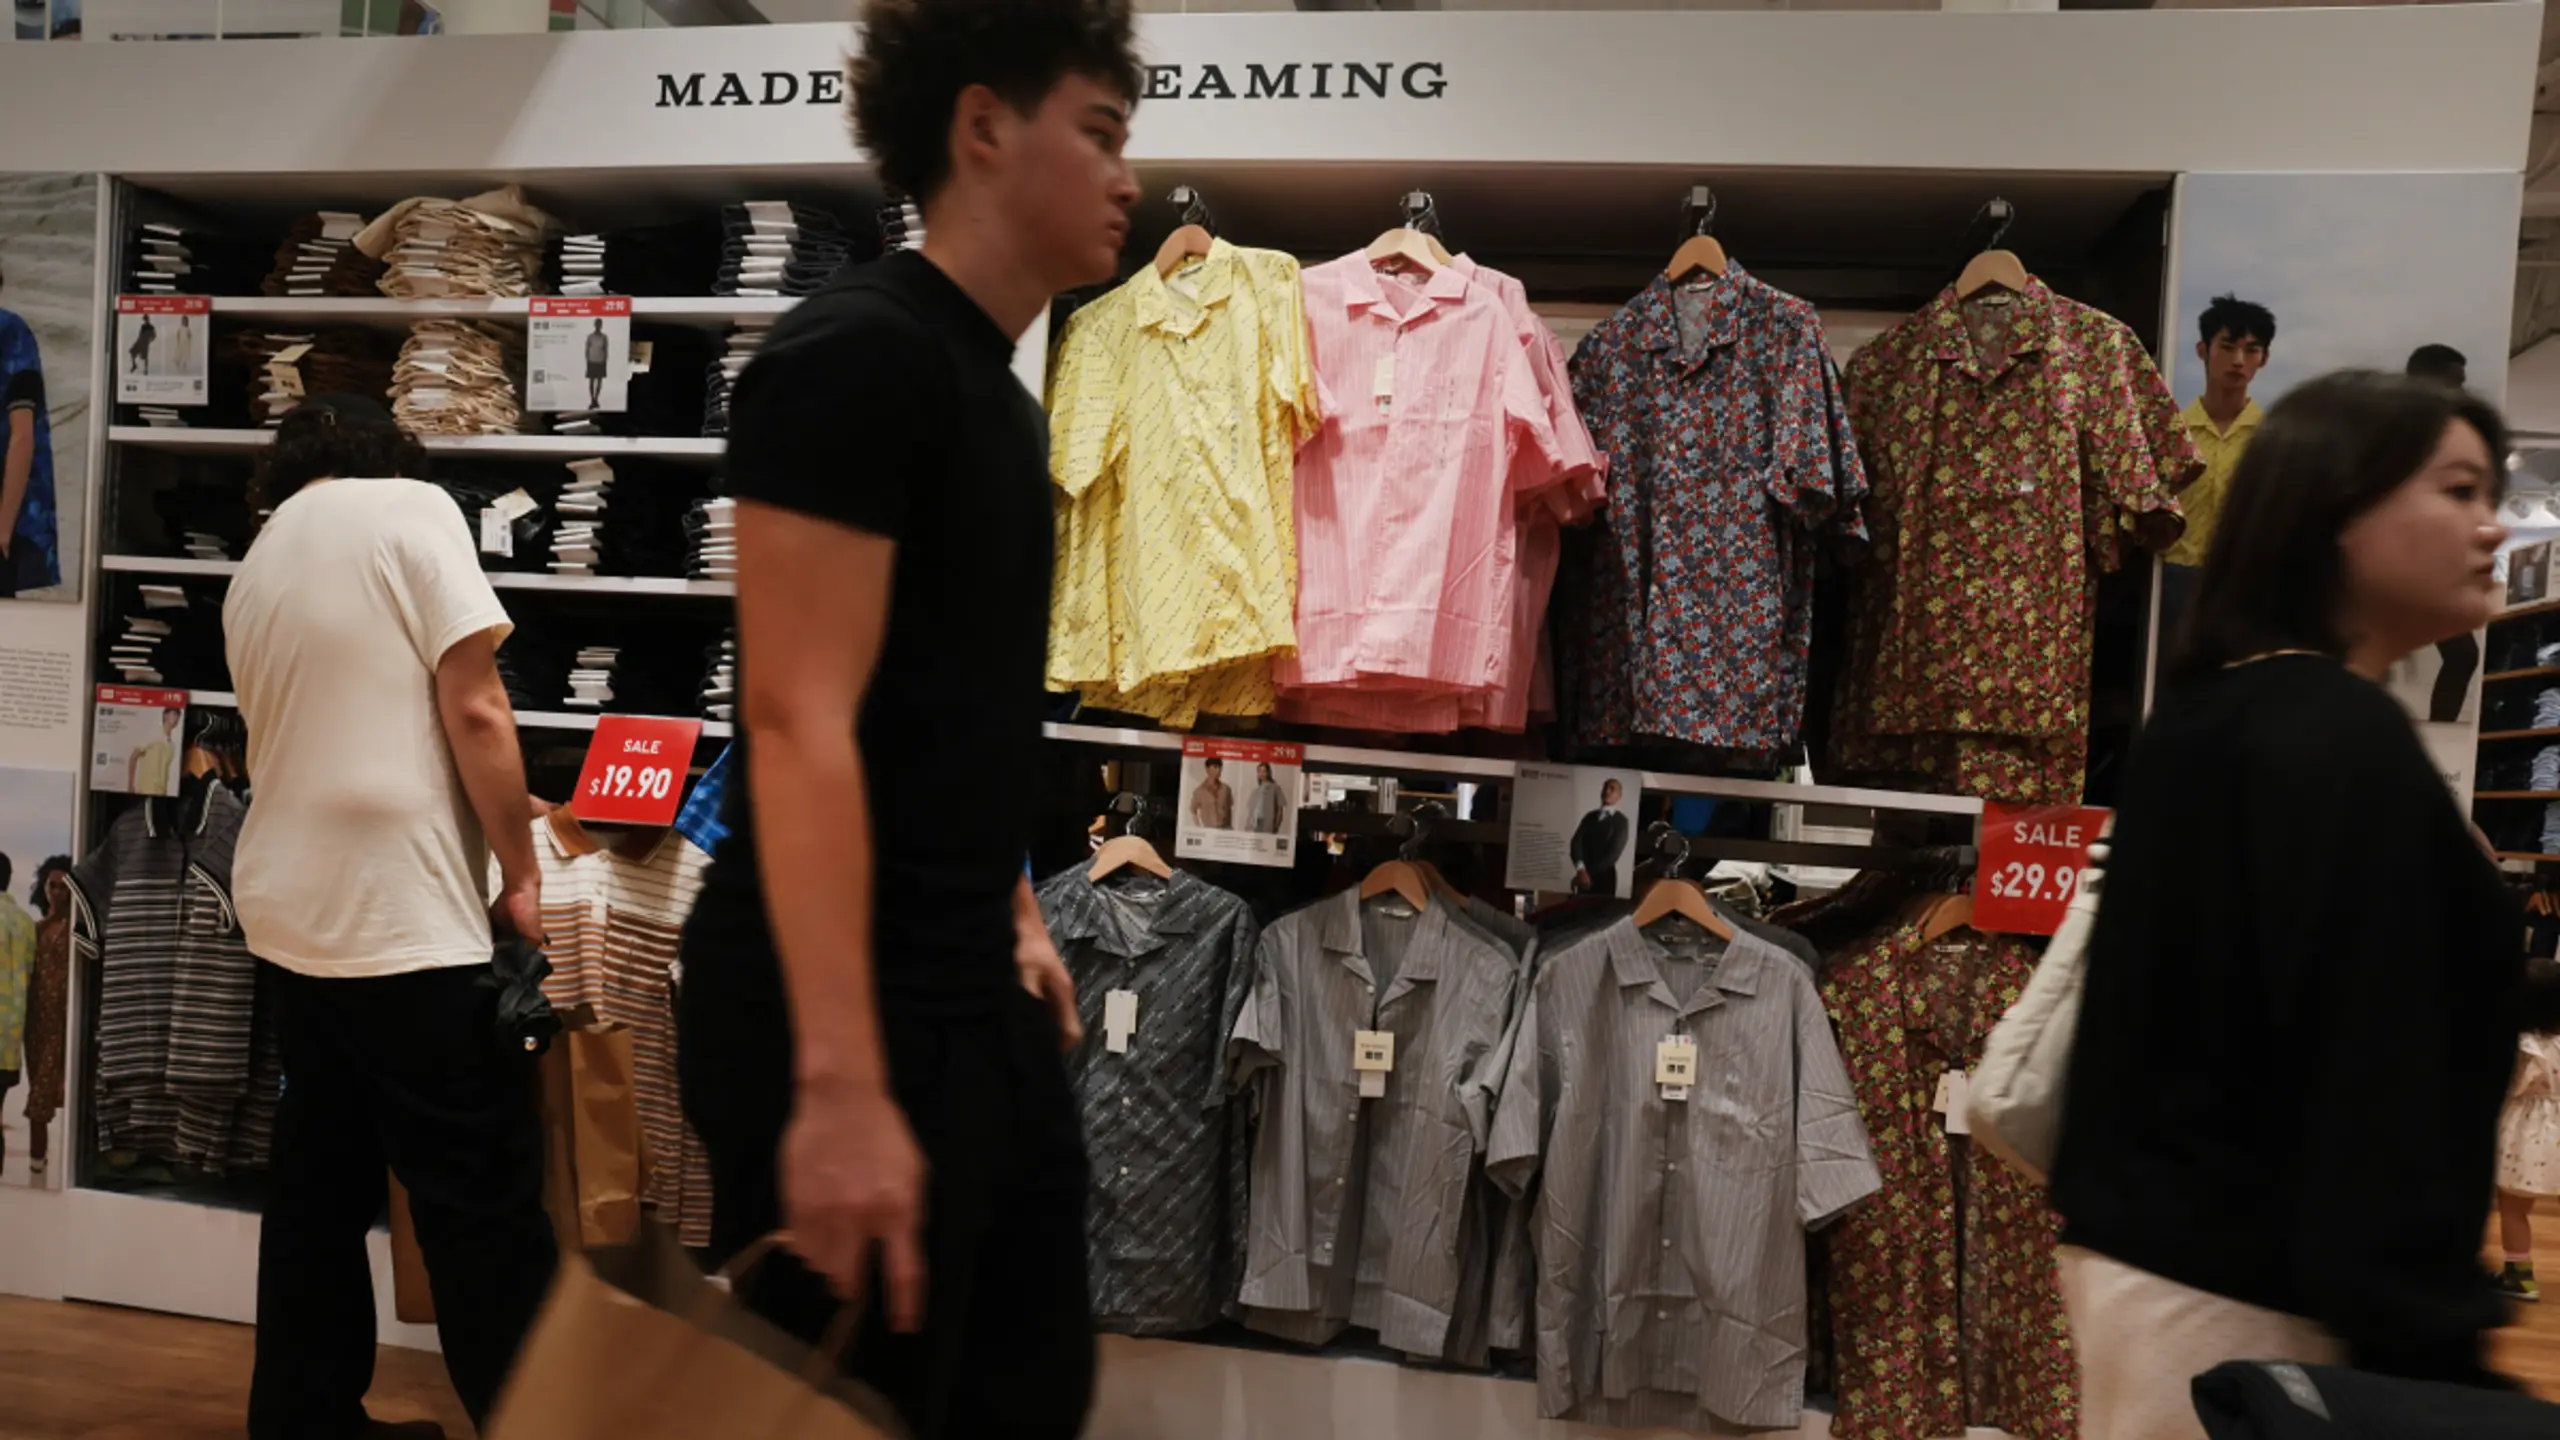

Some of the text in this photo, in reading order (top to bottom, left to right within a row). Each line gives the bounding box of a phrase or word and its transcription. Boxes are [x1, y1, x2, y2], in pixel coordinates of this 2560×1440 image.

[655, 61, 1448, 107] MADE EAMING
[623, 738, 662, 755] SALE
[589, 764, 672, 799] $19.90
[2013, 820, 2083, 849] SALE
